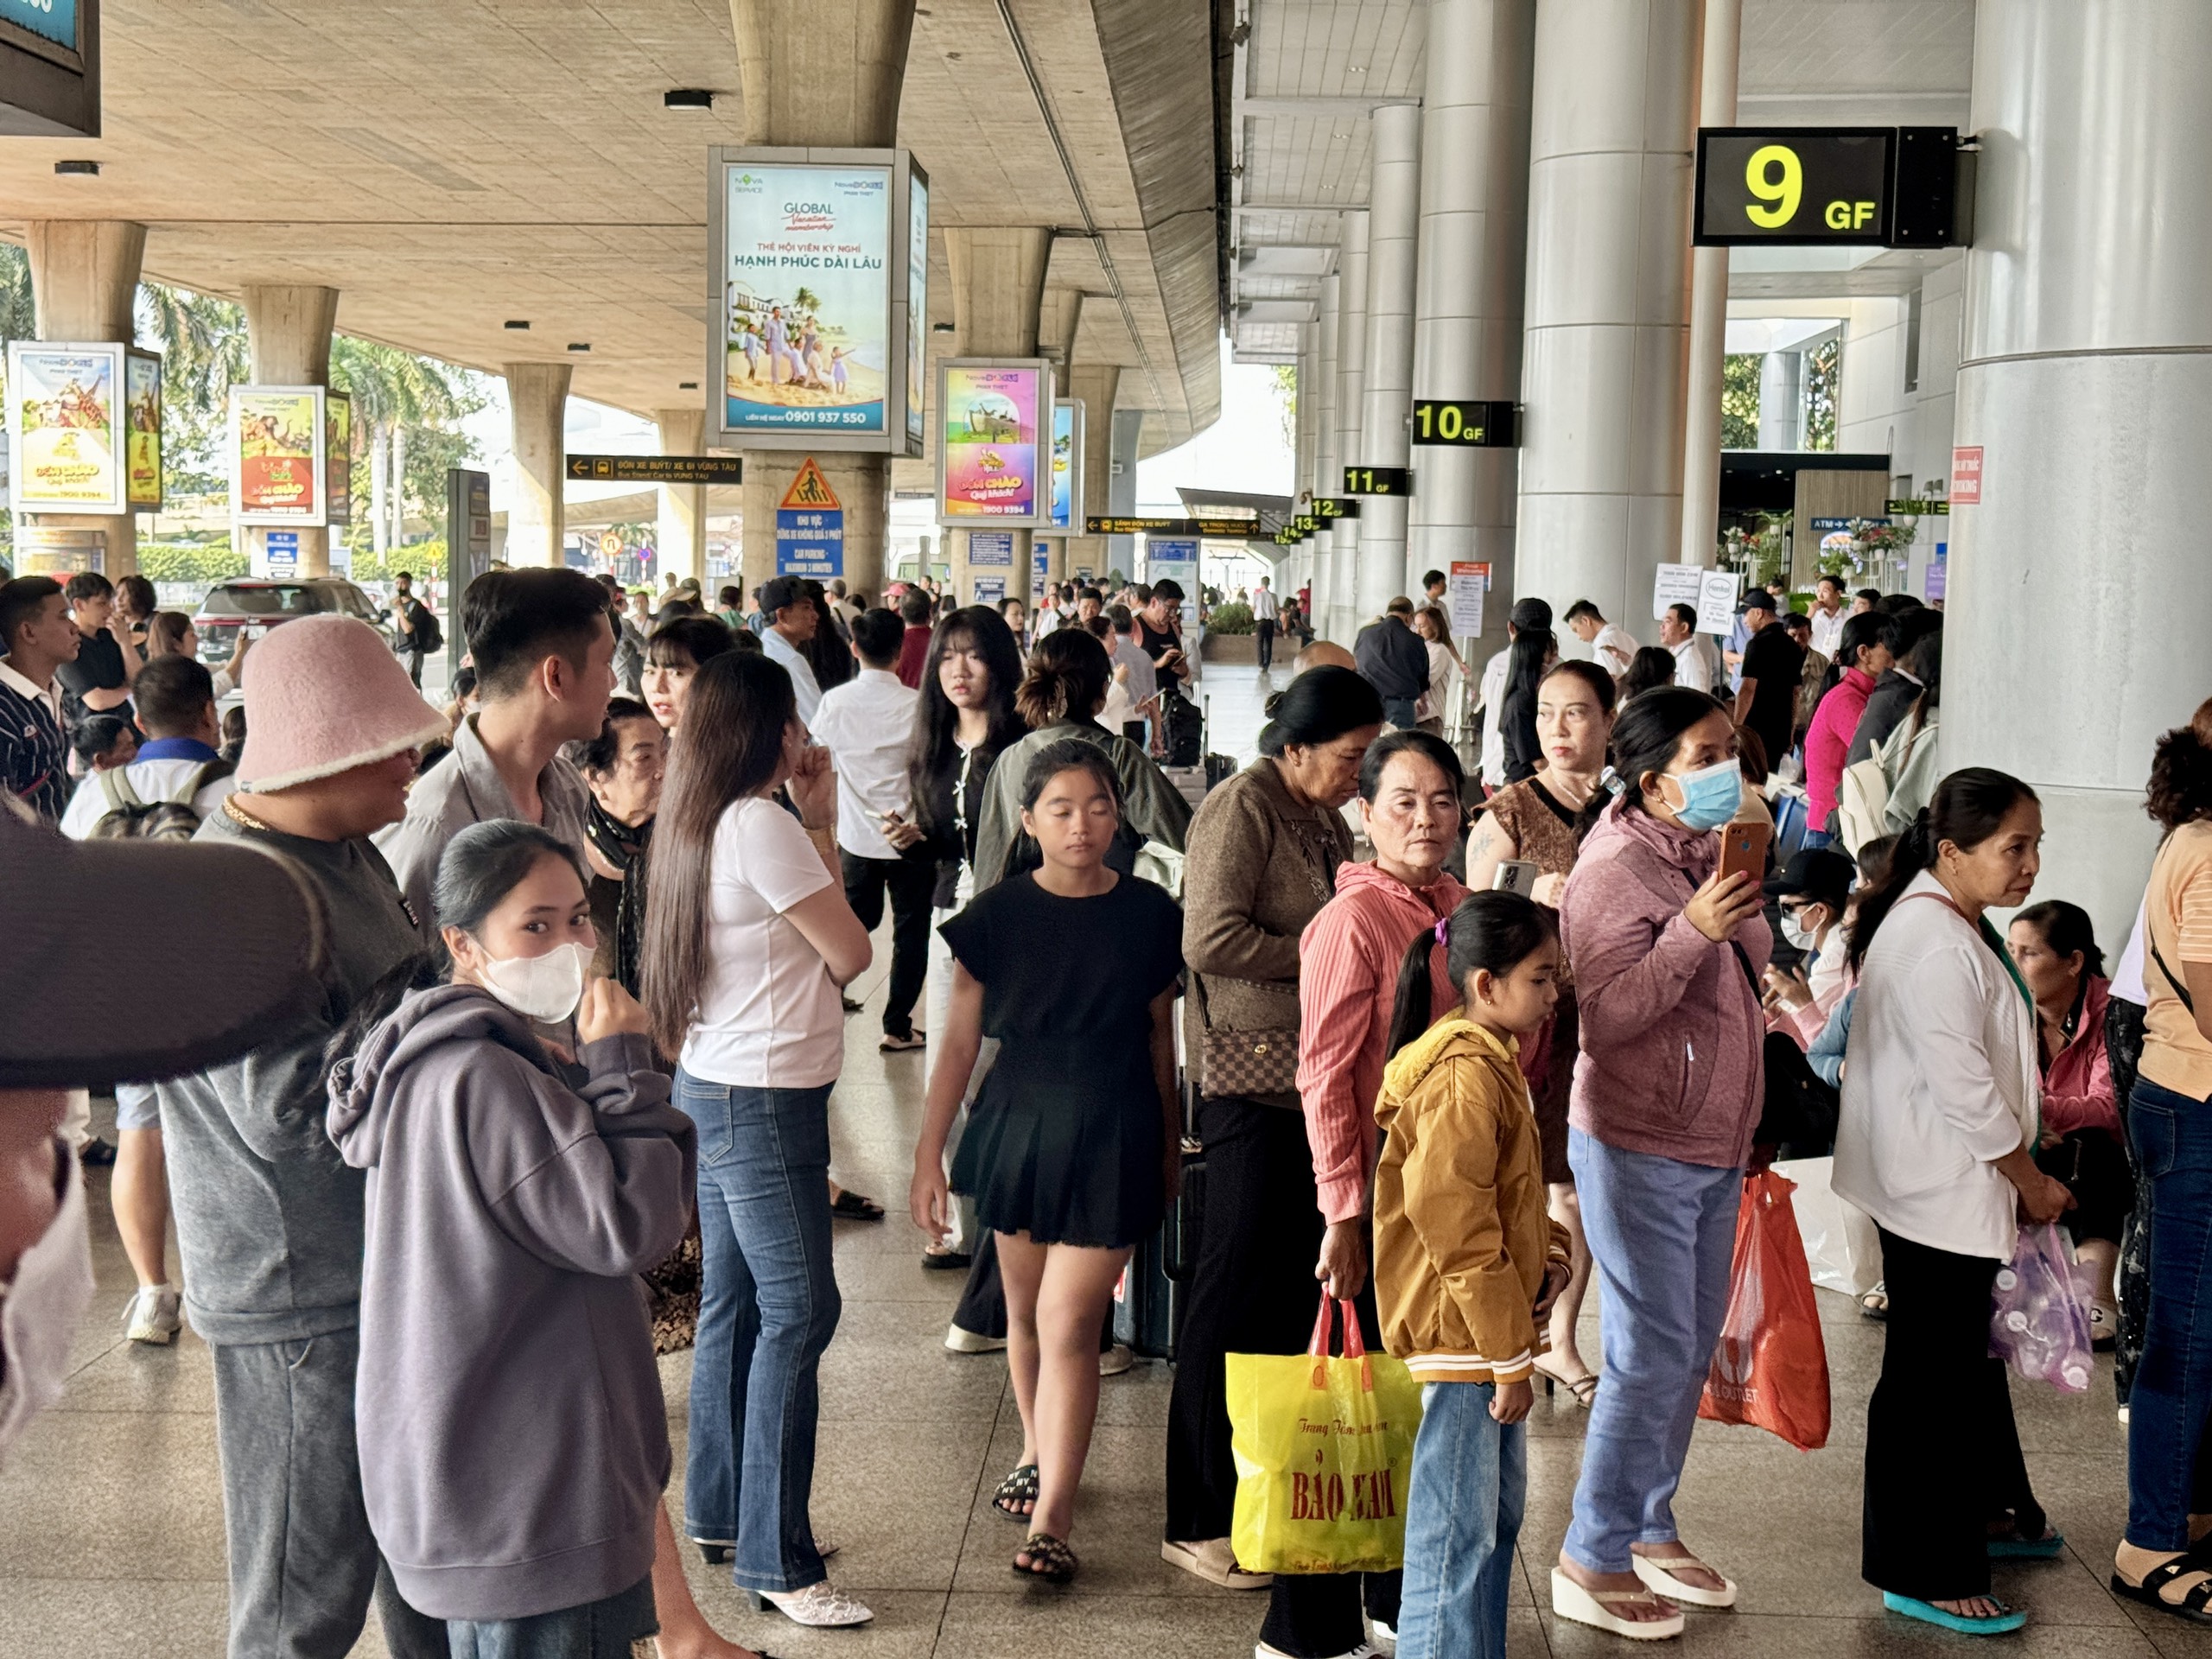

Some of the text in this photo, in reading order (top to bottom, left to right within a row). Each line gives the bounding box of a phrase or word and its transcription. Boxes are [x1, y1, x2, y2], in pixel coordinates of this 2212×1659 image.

[1745, 145, 1802, 228] 9
[784, 202, 833, 214] GLOBAL
[1825, 201, 1876, 230] GF
[785, 223, 834, 232] membership
[779, 242, 795, 253] HỘI
[798, 243, 819, 251] VIÊN
[734, 253, 881, 270] HẠNH PHÚC DÀI LÂU
[785, 410, 815, 423] 0901
[817, 412, 840, 423] 937
[842, 412, 866, 423] 550
[1416, 405, 1484, 441] 10 GF
[618, 461, 636, 469] ĐÓN
[1347, 470, 1373, 492] 11
[1312, 500, 1333, 516] 12
[1296, 517, 1313, 530] 13
[1016, 1478, 1030, 1486] NY
